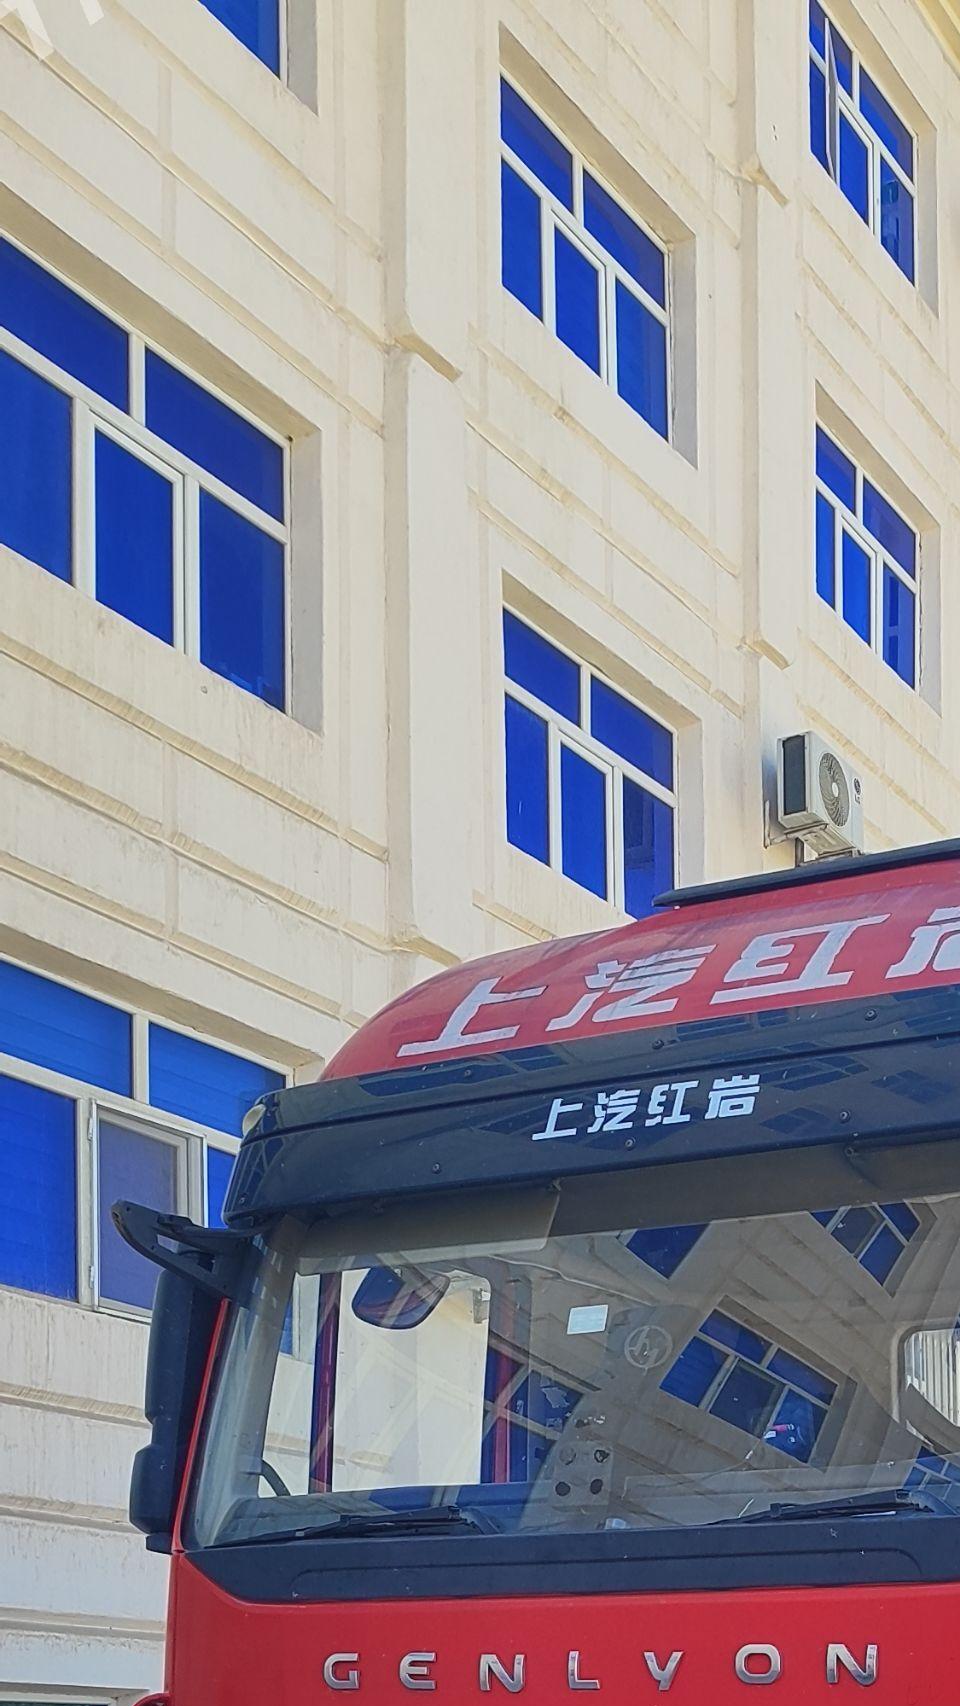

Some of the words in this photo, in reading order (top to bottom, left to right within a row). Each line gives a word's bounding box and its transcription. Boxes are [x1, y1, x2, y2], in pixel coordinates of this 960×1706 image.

[531, 1073, 761, 1142] 上汽红岩
[323, 1643, 878, 1693] GENLYON
